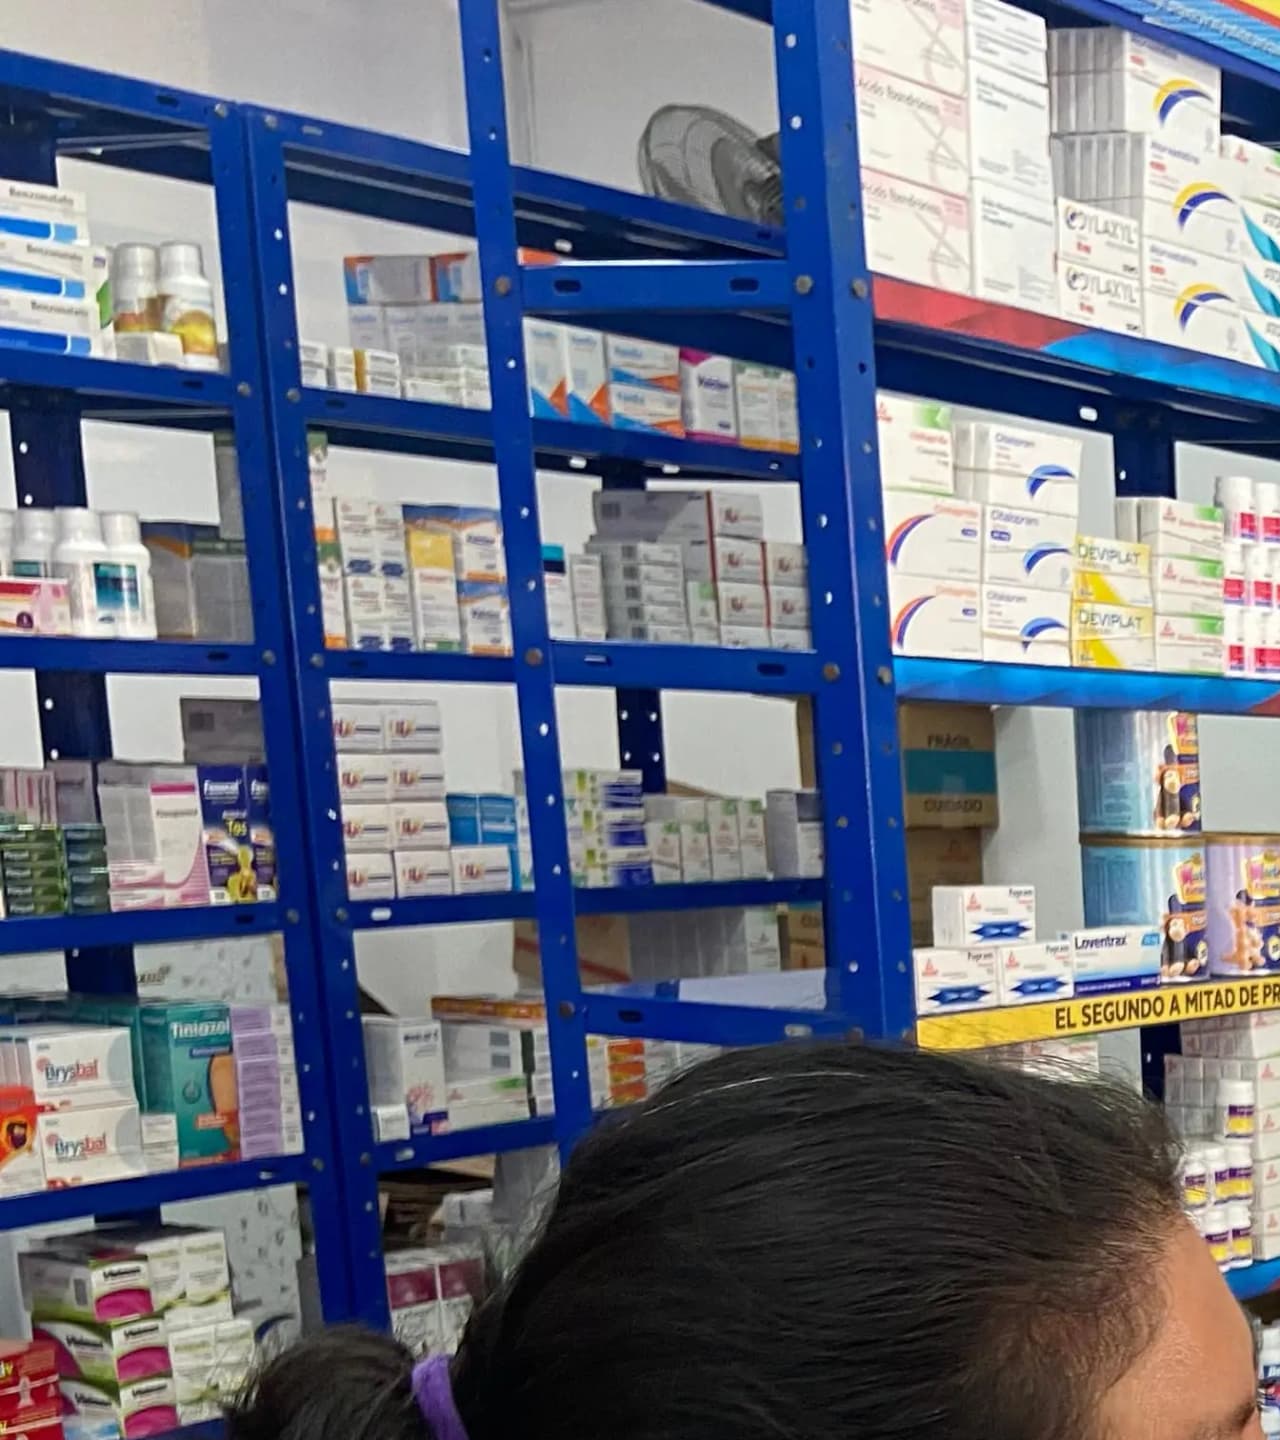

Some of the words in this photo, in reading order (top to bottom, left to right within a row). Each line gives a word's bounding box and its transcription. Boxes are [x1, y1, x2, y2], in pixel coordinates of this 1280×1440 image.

[1078, 541, 1142, 565] DEVIPLAT
[1078, 605, 1144, 631] DEVIPLAT
[1074, 934, 1127, 949] Loventrax
[1055, 1006, 1077, 1030] EL
[1081, 998, 1165, 1027] SEGUNDO
[1169, 998, 1181, 1016] A
[1184, 987, 1235, 1013] MITAD
[1239, 985, 1260, 1002] DE
